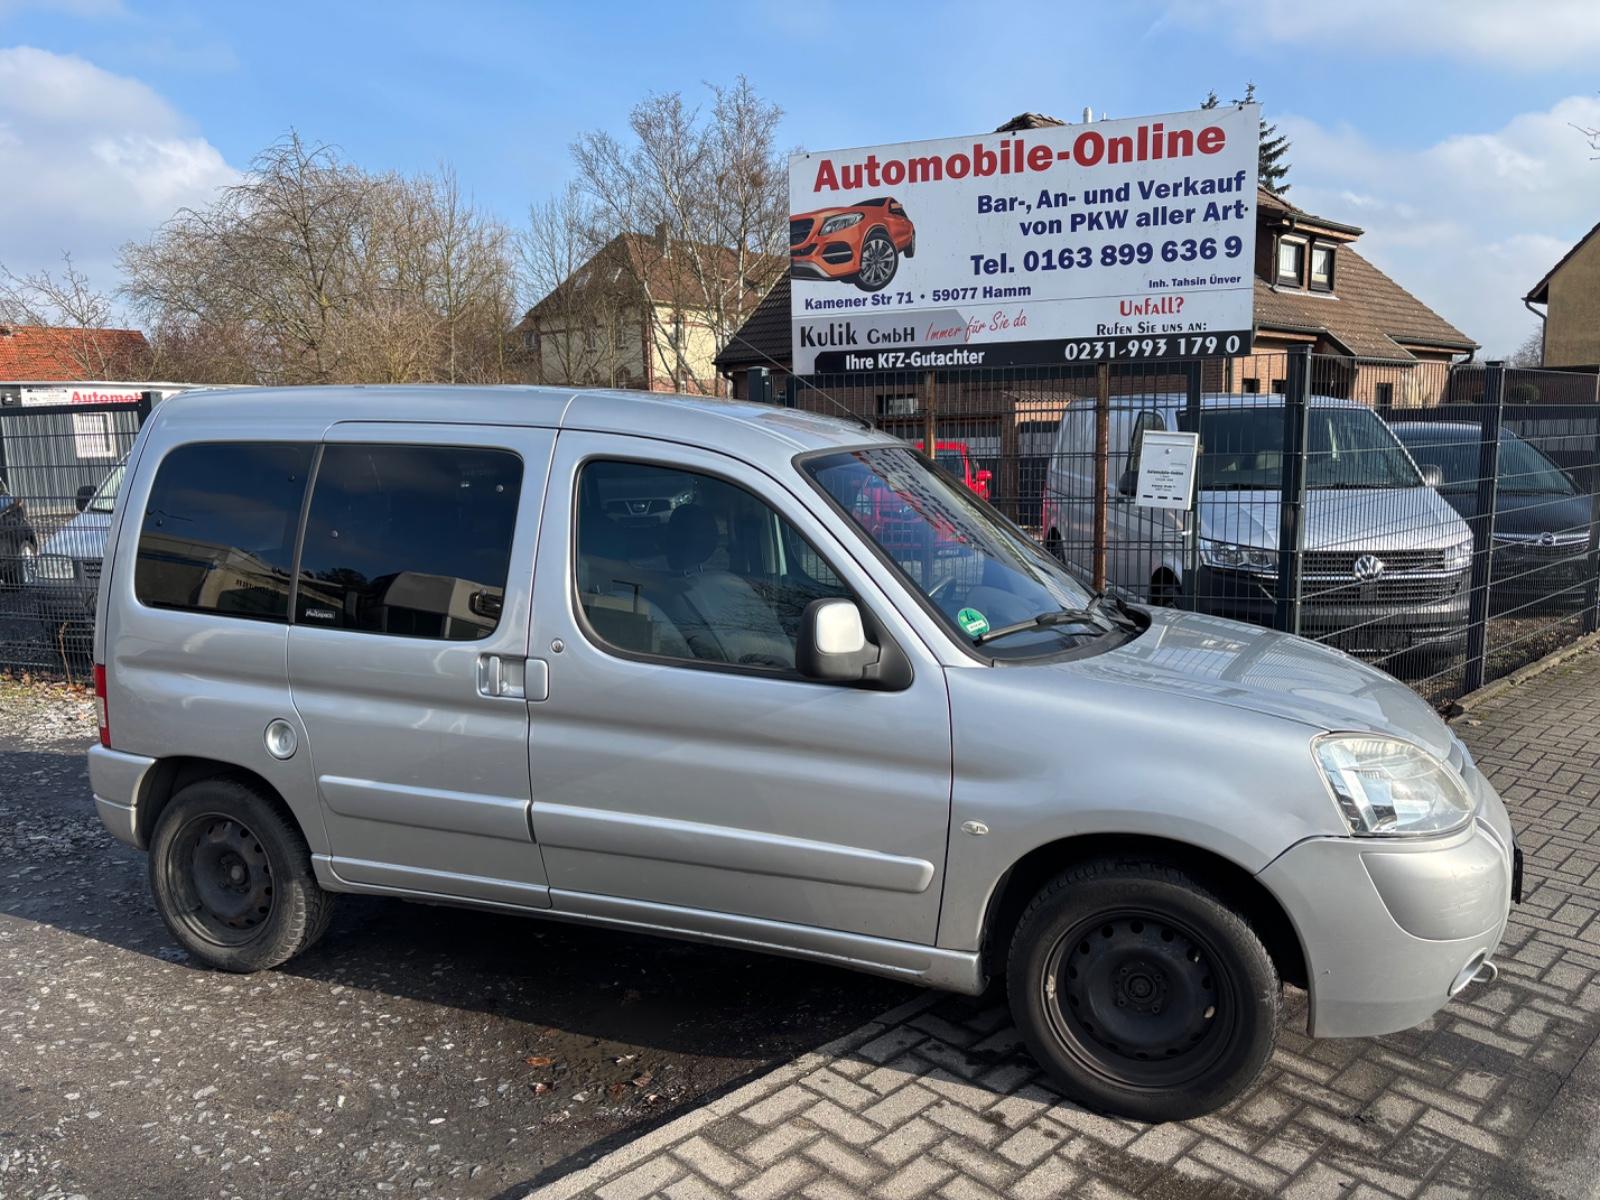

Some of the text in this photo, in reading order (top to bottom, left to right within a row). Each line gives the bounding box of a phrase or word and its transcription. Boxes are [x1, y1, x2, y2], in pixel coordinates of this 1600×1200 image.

[813, 123, 1226, 192] Automobile-Online
[977, 170, 1246, 214] Bar-, An- und Verkauf
[1019, 217, 1062, 236] von
[1070, 209, 1128, 232] PKW
[1136, 205, 1195, 227] aller
[970, 253, 1015, 275] Tel.
[1023, 246, 1093, 272] 0163
[1100, 241, 1154, 267] 899
[1149, 274, 1242, 289] Inh. Tahsin Ünver
[805, 285, 1032, 310] Kamener Str 71 59077 Hamm
[800, 322, 858, 348] Kulik
[925, 308, 1028, 343] Immer für Sie da
[845, 350, 985, 370] Ihre KFZ-Gutachter
[1064, 338, 1167, 361] 0231-993
[964, 610, 976, 622] 4
